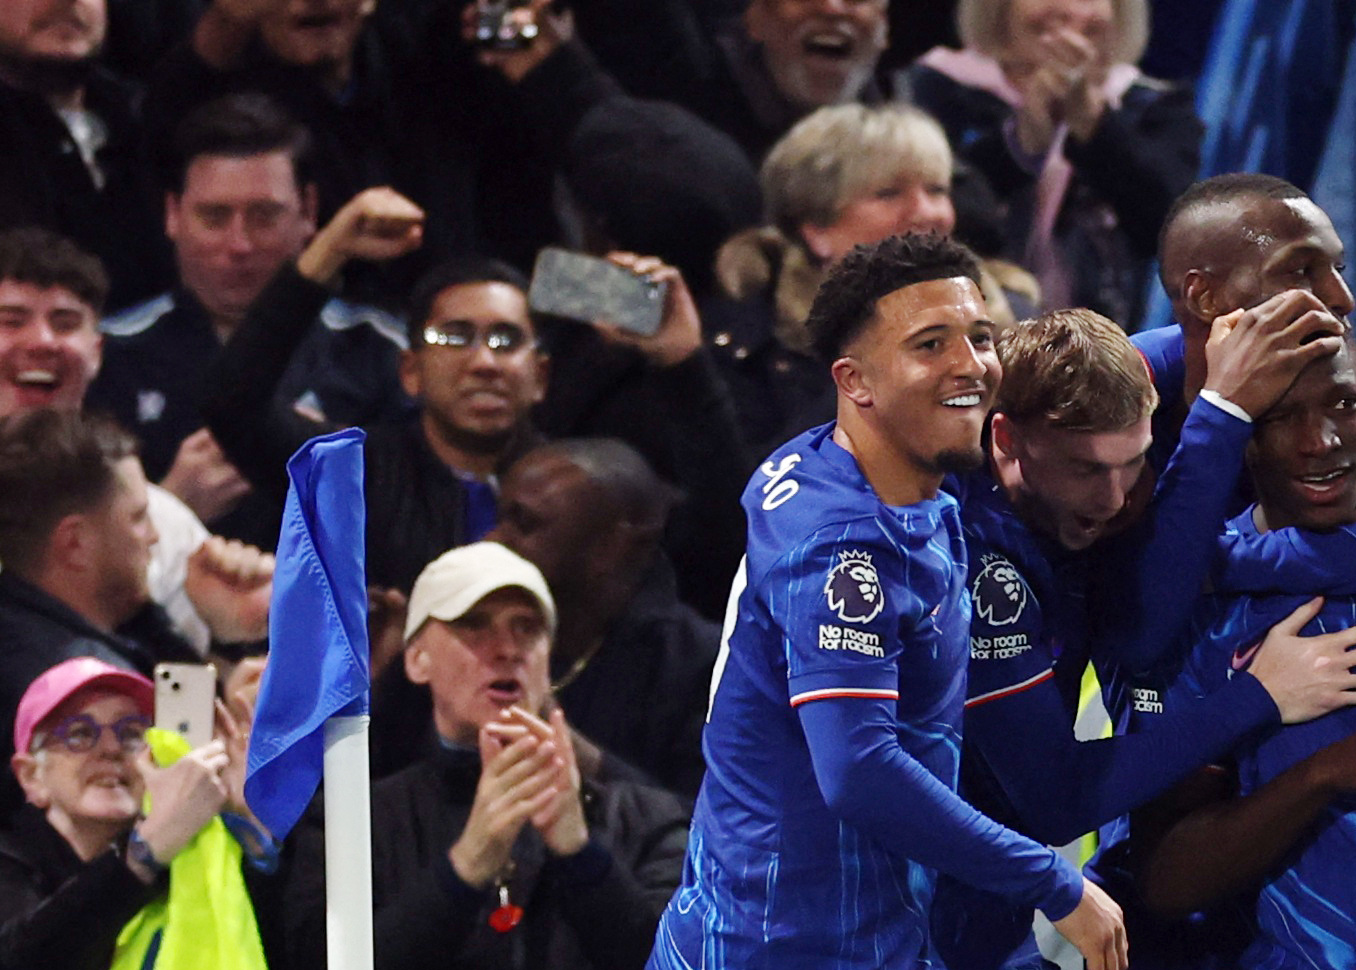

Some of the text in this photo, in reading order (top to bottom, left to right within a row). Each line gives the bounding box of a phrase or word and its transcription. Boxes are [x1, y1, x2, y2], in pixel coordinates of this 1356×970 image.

[818, 624, 880, 646] No room
[970, 633, 1027, 649] No room
